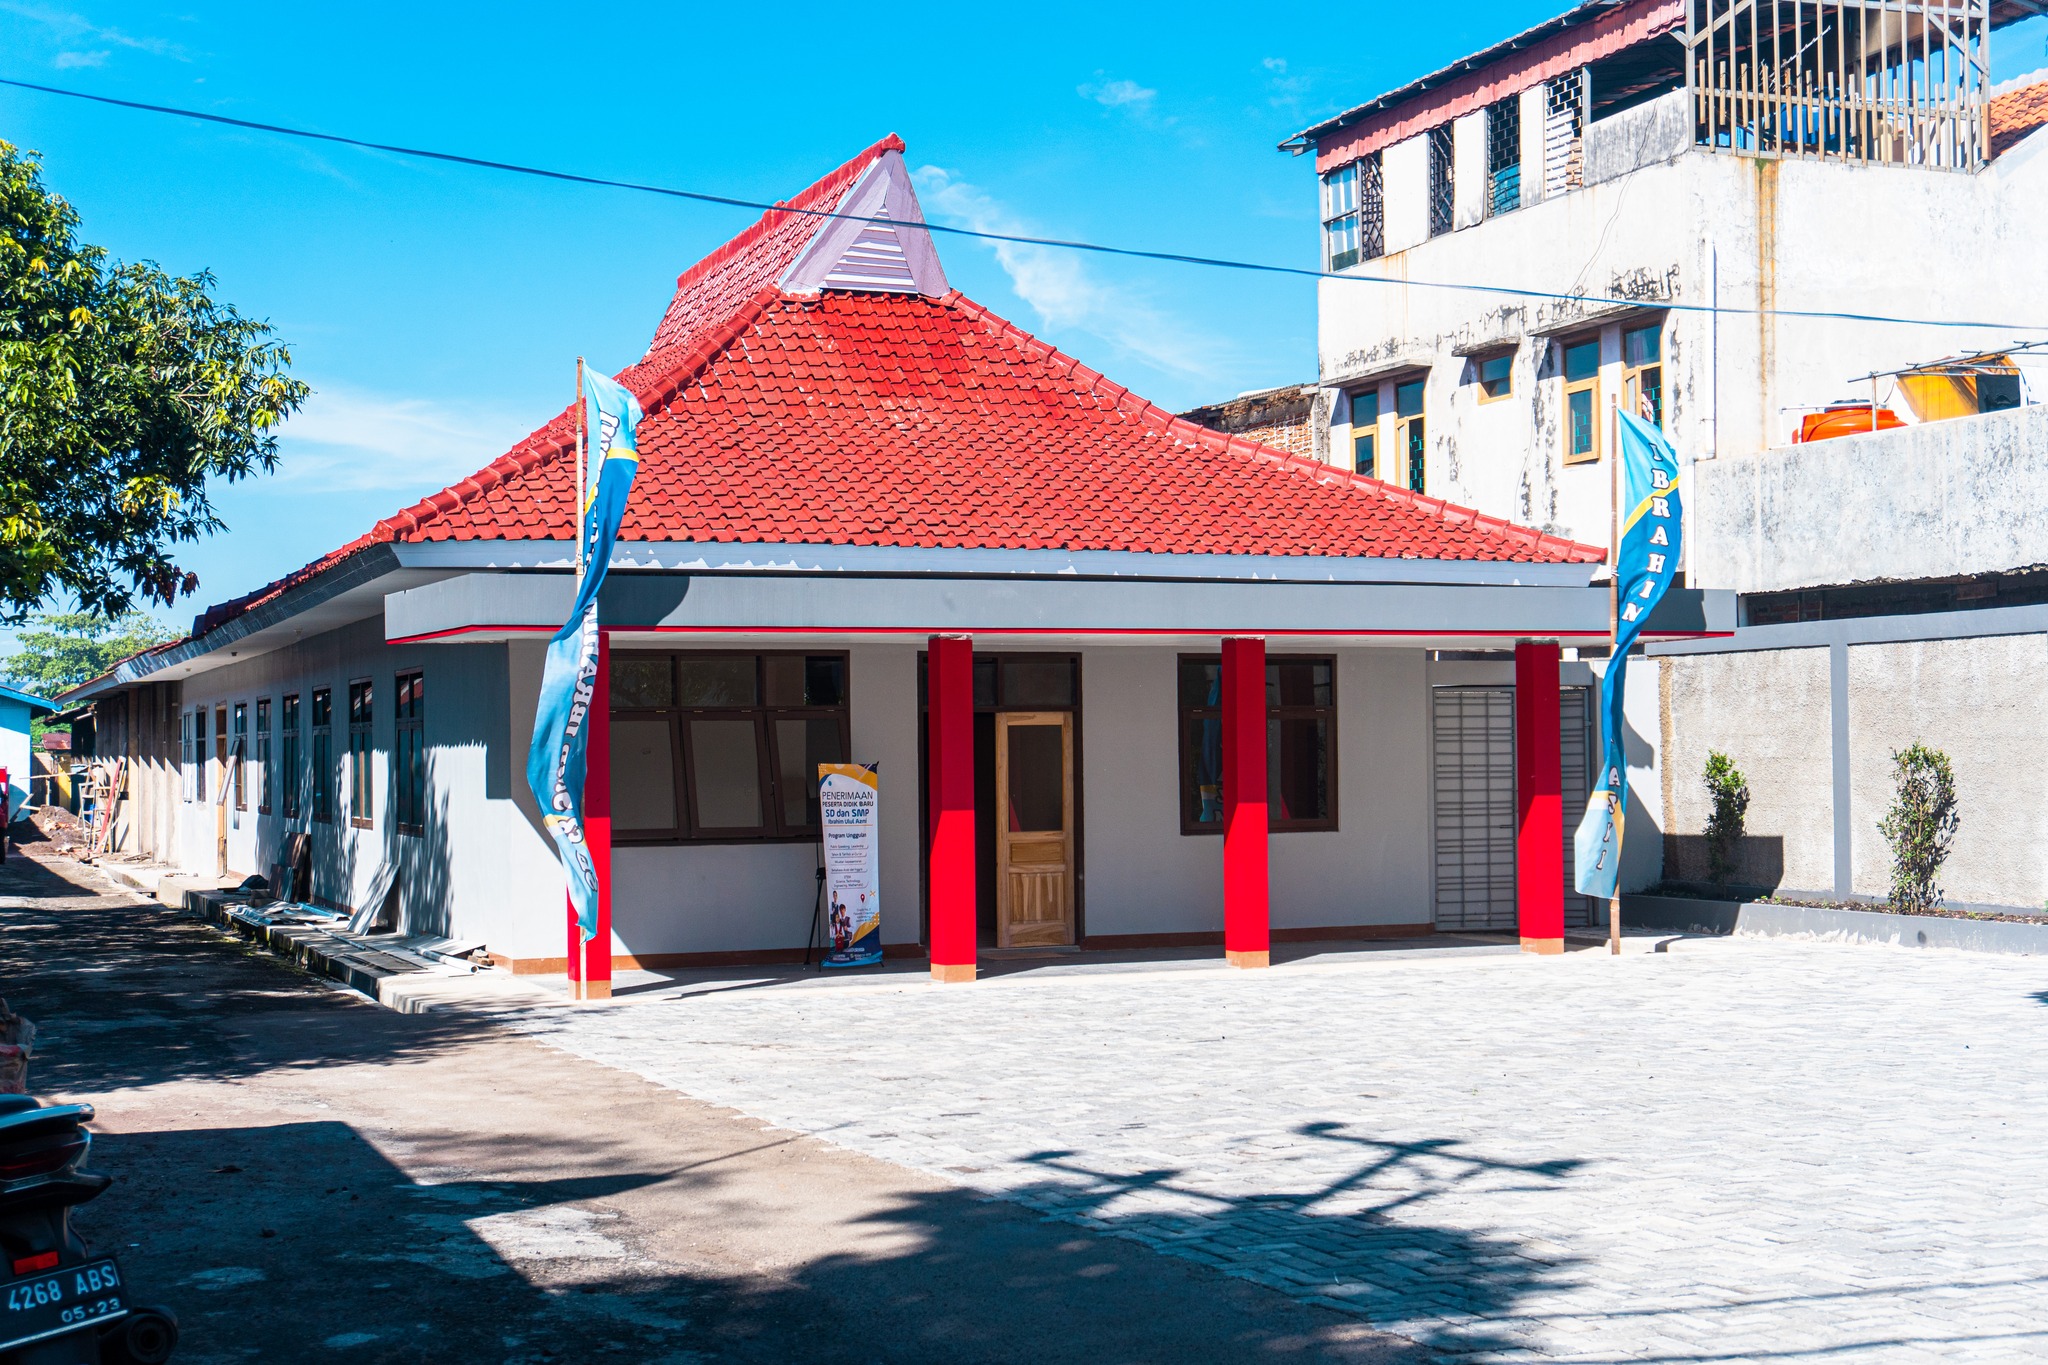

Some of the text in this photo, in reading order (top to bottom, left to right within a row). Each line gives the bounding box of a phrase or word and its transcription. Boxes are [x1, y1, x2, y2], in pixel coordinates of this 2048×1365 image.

[822, 791, 873, 800] PENERIMAAN
[825, 808, 870, 817] SD dan SMP
[8, 1265, 118, 1312] 4268 ABS
